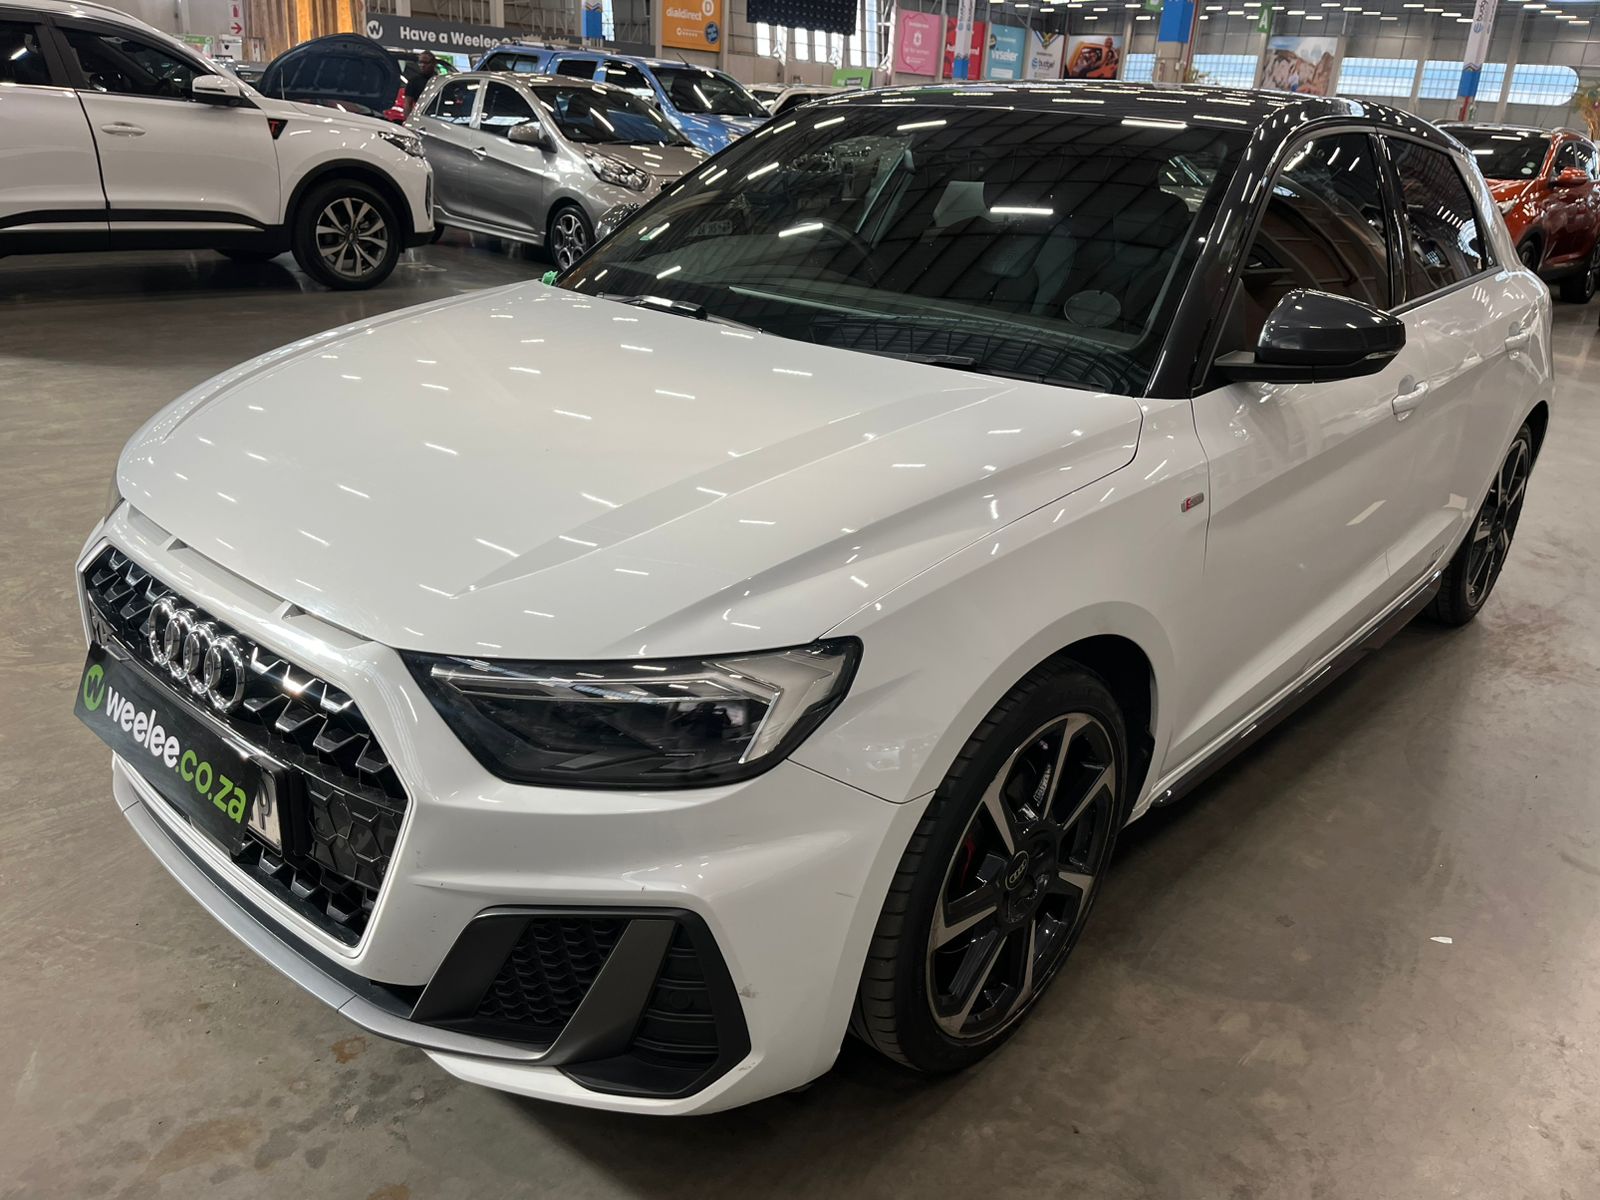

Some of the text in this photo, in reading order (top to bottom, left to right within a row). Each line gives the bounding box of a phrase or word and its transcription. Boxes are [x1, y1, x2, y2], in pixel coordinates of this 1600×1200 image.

[1259, 9, 1268, 29] A
[400, 26, 436, 43] Have
[439, 33, 448, 44] a
[106, 686, 247, 824] weelee.co.za
